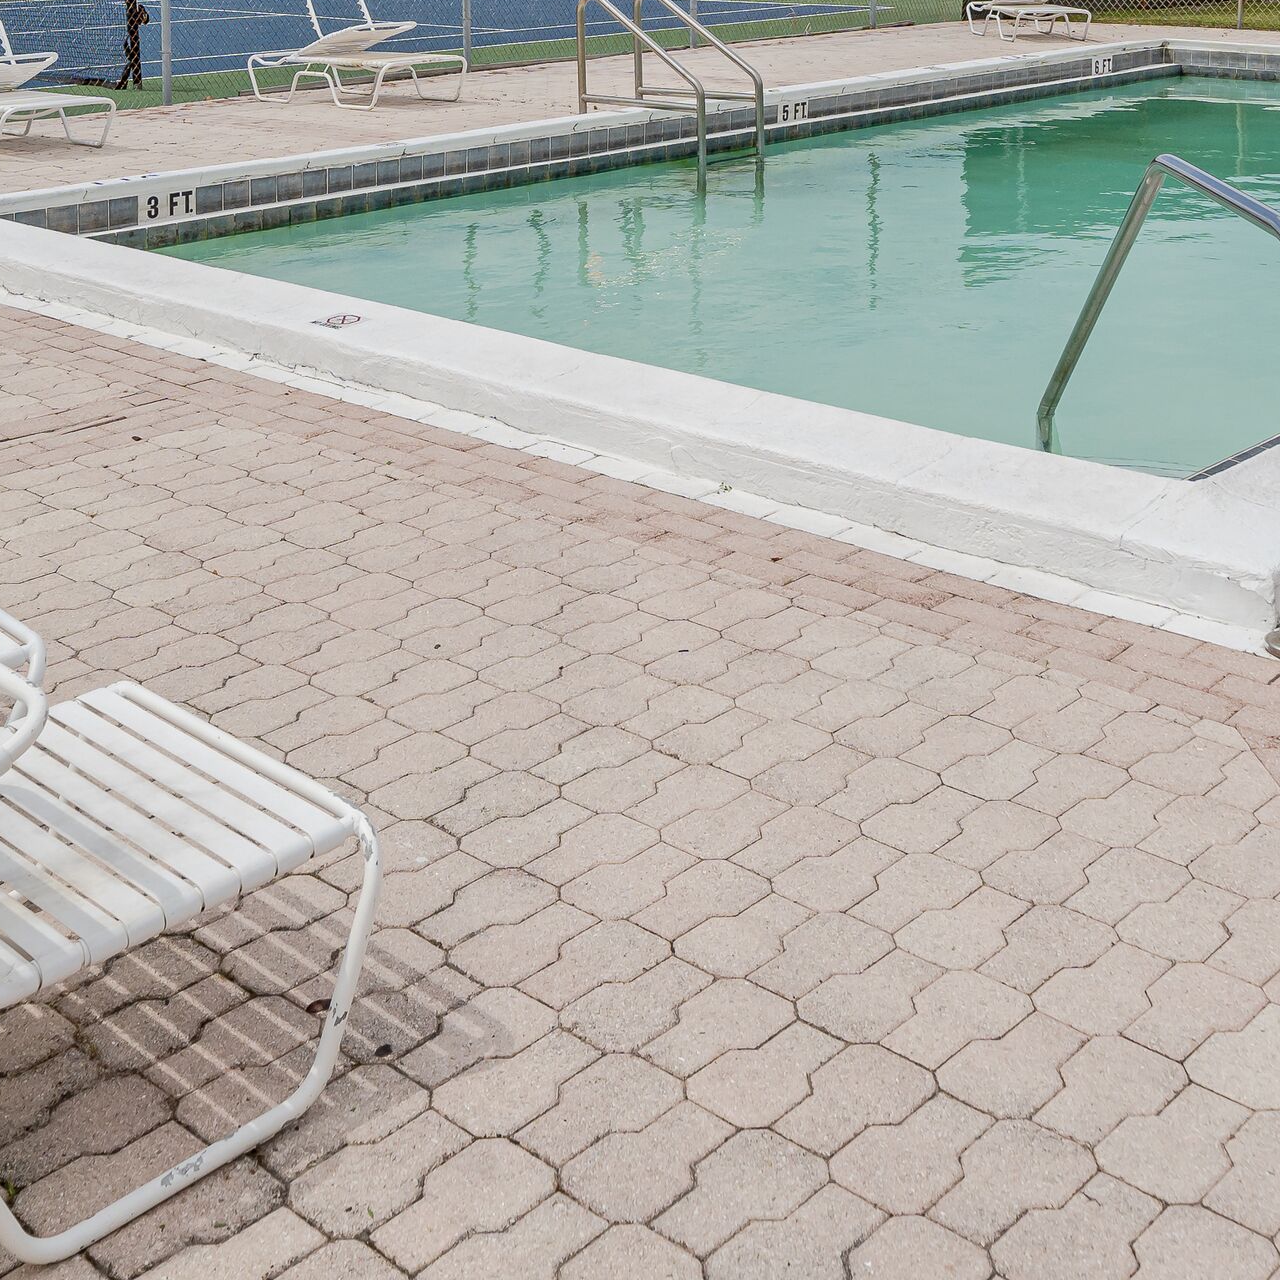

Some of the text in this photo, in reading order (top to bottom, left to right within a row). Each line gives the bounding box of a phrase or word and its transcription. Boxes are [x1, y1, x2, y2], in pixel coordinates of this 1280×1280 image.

[782, 102, 807, 122] 5 FT.
[146, 190, 193, 219] 3 FT.
